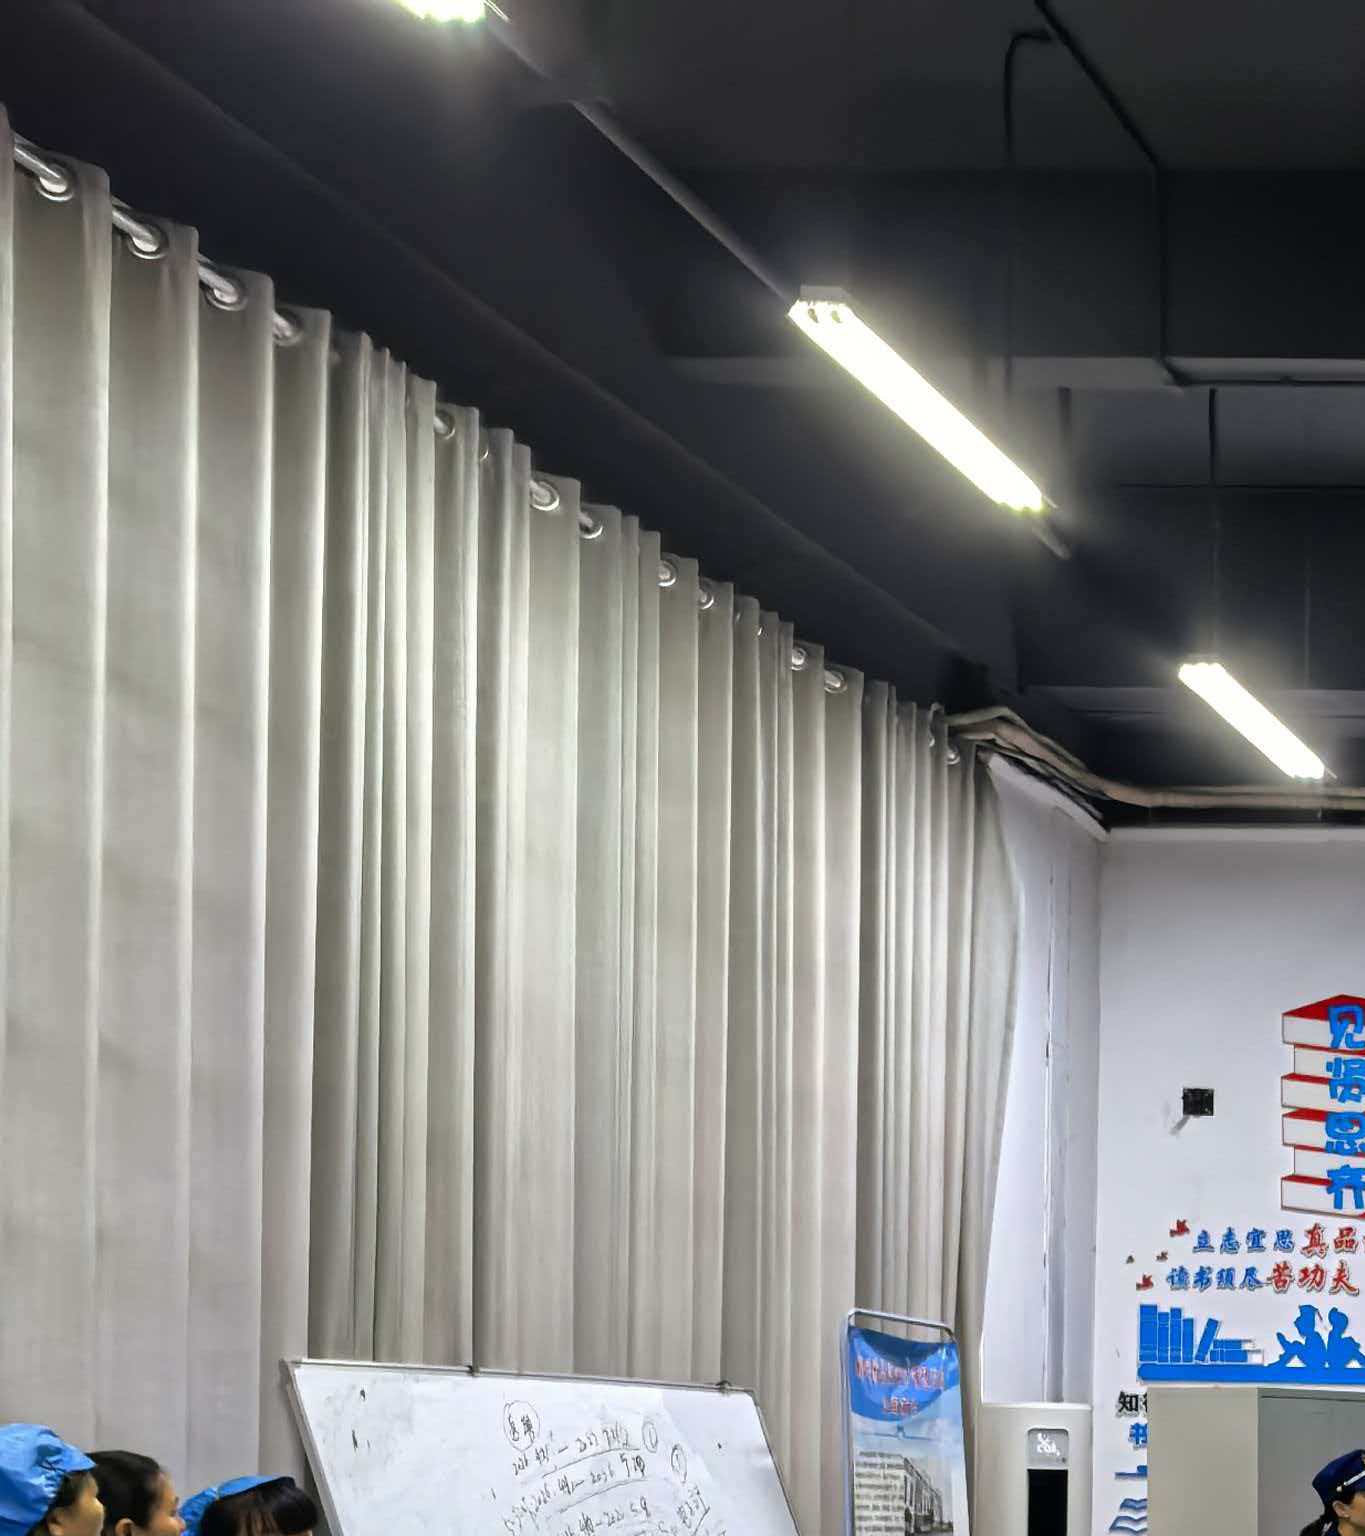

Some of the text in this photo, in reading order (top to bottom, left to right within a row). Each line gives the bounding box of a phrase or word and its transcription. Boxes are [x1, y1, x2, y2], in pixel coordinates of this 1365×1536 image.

[1166, 1261, 1360, 1297] 读书须尽苦功夫
[1117, 1392, 1148, 1414] 知
